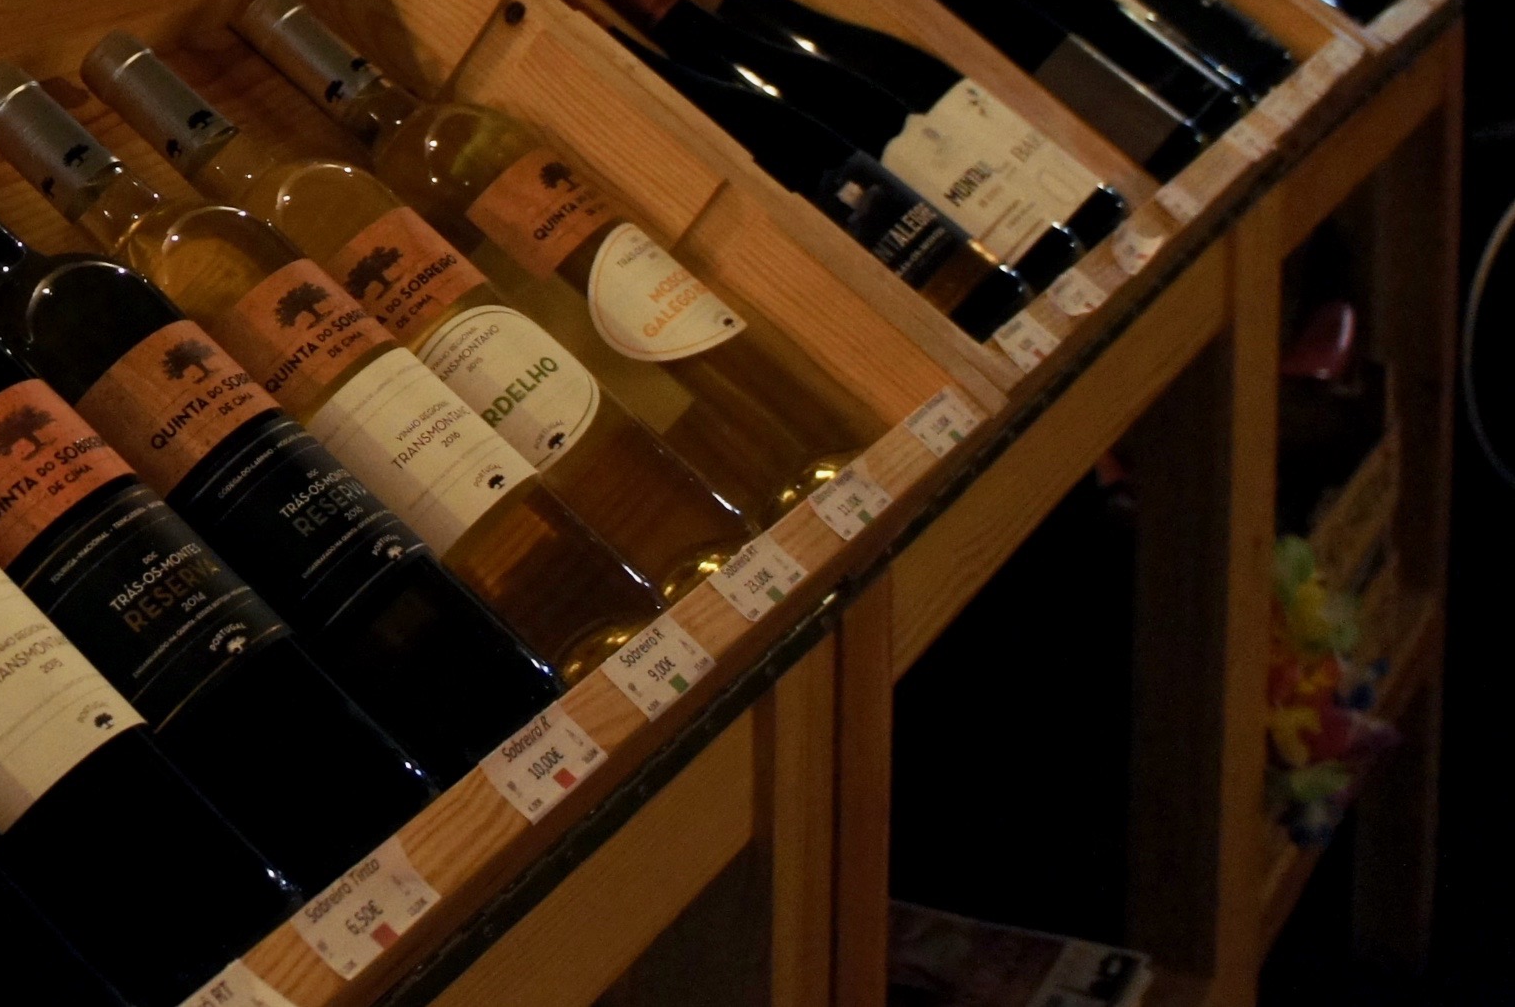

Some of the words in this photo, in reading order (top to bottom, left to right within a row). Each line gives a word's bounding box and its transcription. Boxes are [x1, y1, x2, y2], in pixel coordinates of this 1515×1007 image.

[534, 200, 577, 240] QUINTA
[385, 298, 402, 314] DO
[395, 315, 411, 329] DE
[408, 294, 433, 316] CIMA
[264, 336, 318, 394] QUINTA
[316, 327, 333, 343] DO
[327, 342, 341, 358] DE
[341, 331, 364, 348] CIMA
[150, 397, 209, 450] QUINTA
[207, 386, 224, 400] DO
[218, 403, 234, 417] DE
[395, 418, 421, 442] VINHO
[440, 431, 461, 448] 2016
[36, 461, 56, 477] DO
[47, 480, 65, 496] DE
[64, 463, 93, 484] CIMA
[108, 542, 203, 613] TRÁS-OS-MONTES
[181, 591, 208, 613] 2014
[209, 621, 248, 652] PORTUGAL
[619, 635, 658, 668] Sobreiro
[653, 627, 666, 640] R
[647, 655, 677, 682] 9,00€
[501, 724, 544, 764] Sobreiro
[541, 714, 552, 731] R
[528, 746, 565, 781] 10,00€
[304, 882, 354, 924] Sobreiro
[348, 858, 382, 886] Tinto
[345, 899, 384, 936] 6,50€
